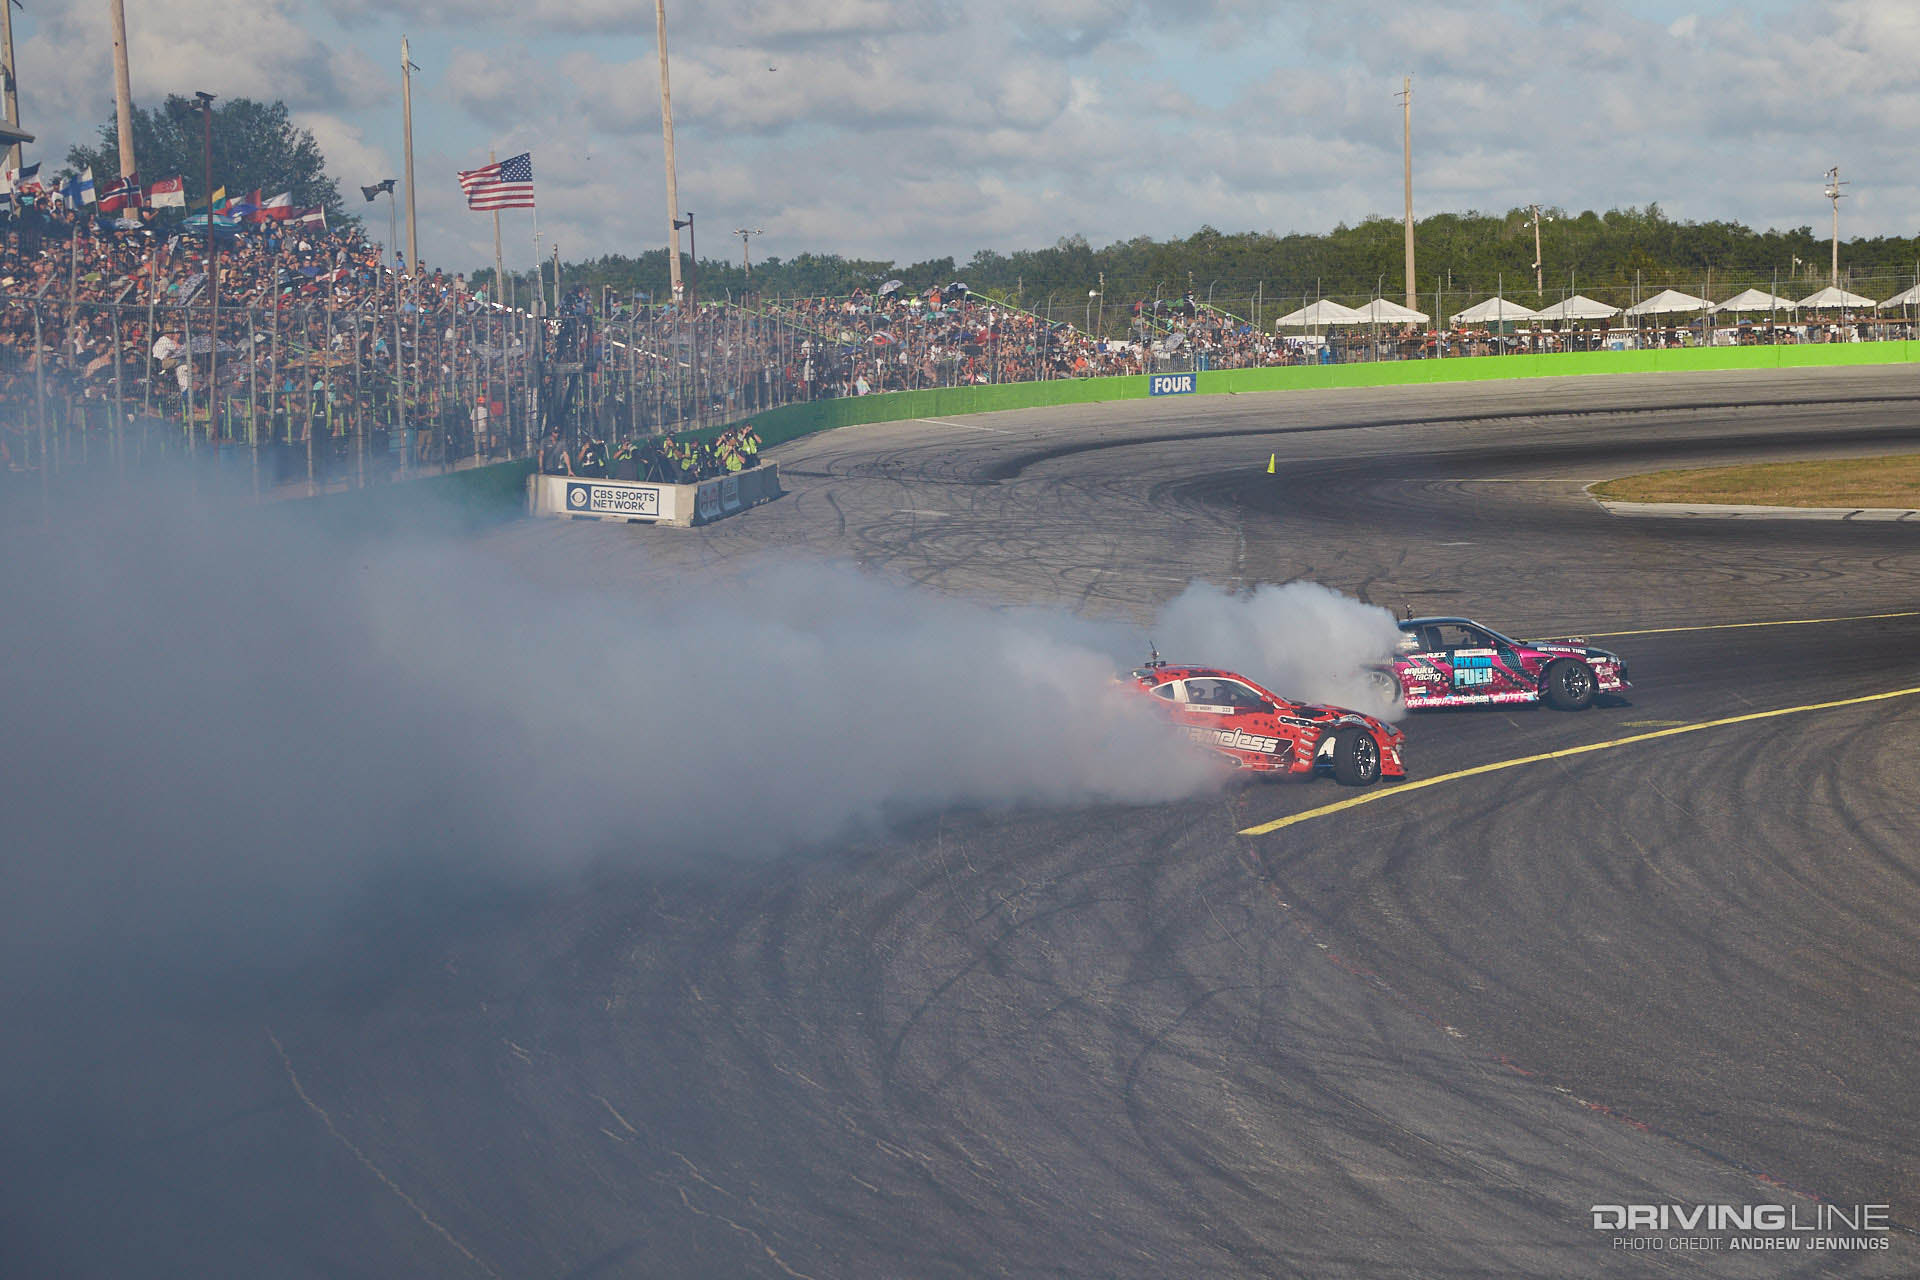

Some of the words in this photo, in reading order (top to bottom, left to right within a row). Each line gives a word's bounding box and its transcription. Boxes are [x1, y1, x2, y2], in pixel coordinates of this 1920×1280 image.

[1154, 376, 1191, 393] FOUR
[593, 489, 613, 499] CBS
[615, 491, 655, 502] SPORTS
[593, 500, 645, 511] NETWORK
[1453, 656, 1471, 668] FIX
[1404, 666, 1434, 676] enjuku
[1454, 667, 1493, 686] FUEL!
[1415, 673, 1441, 682] racing
